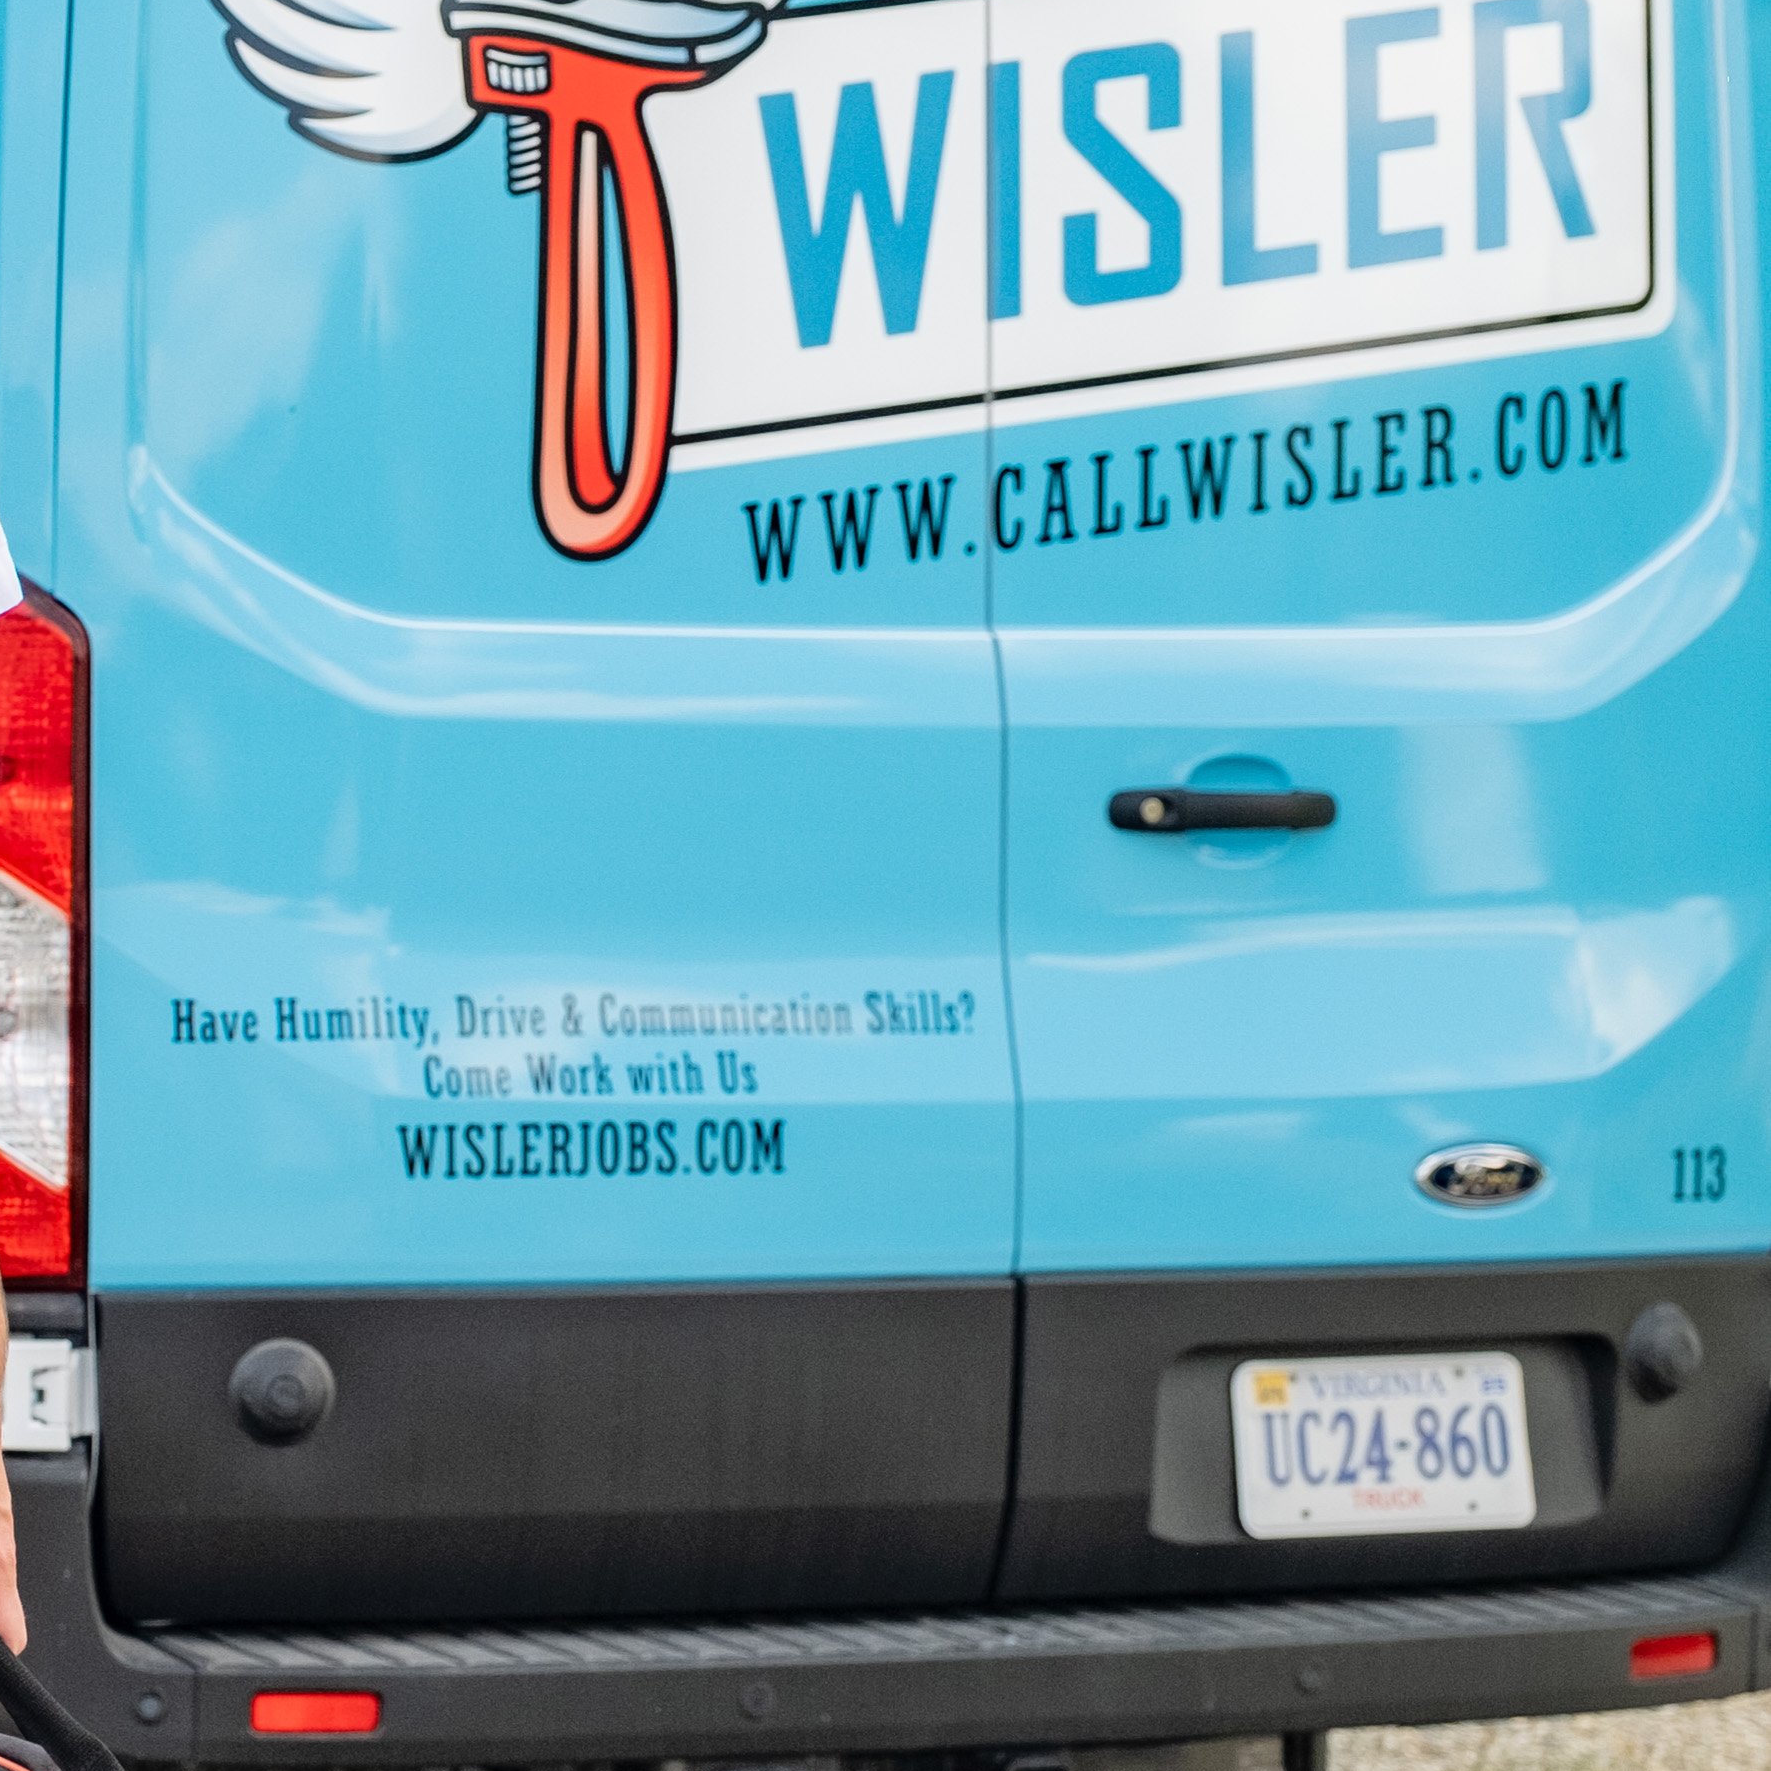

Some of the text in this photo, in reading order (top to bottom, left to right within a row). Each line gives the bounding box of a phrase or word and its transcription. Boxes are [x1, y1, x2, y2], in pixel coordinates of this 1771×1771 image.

[742, 381, 1632, 584] WWW.CALLWISLER.COM
[171, 989, 976, 1048] Have Humility, Drive & Communication Skills?
[424, 1050, 759, 1099] Come Work with Us
[398, 1119, 787, 1178] WISLERJOBS.COM
[1673, 1146, 1726, 1201] 113
[1309, 1372, 1447, 1399] VIRGINIA
[1261, 1402, 1510, 1486] UC24-860
